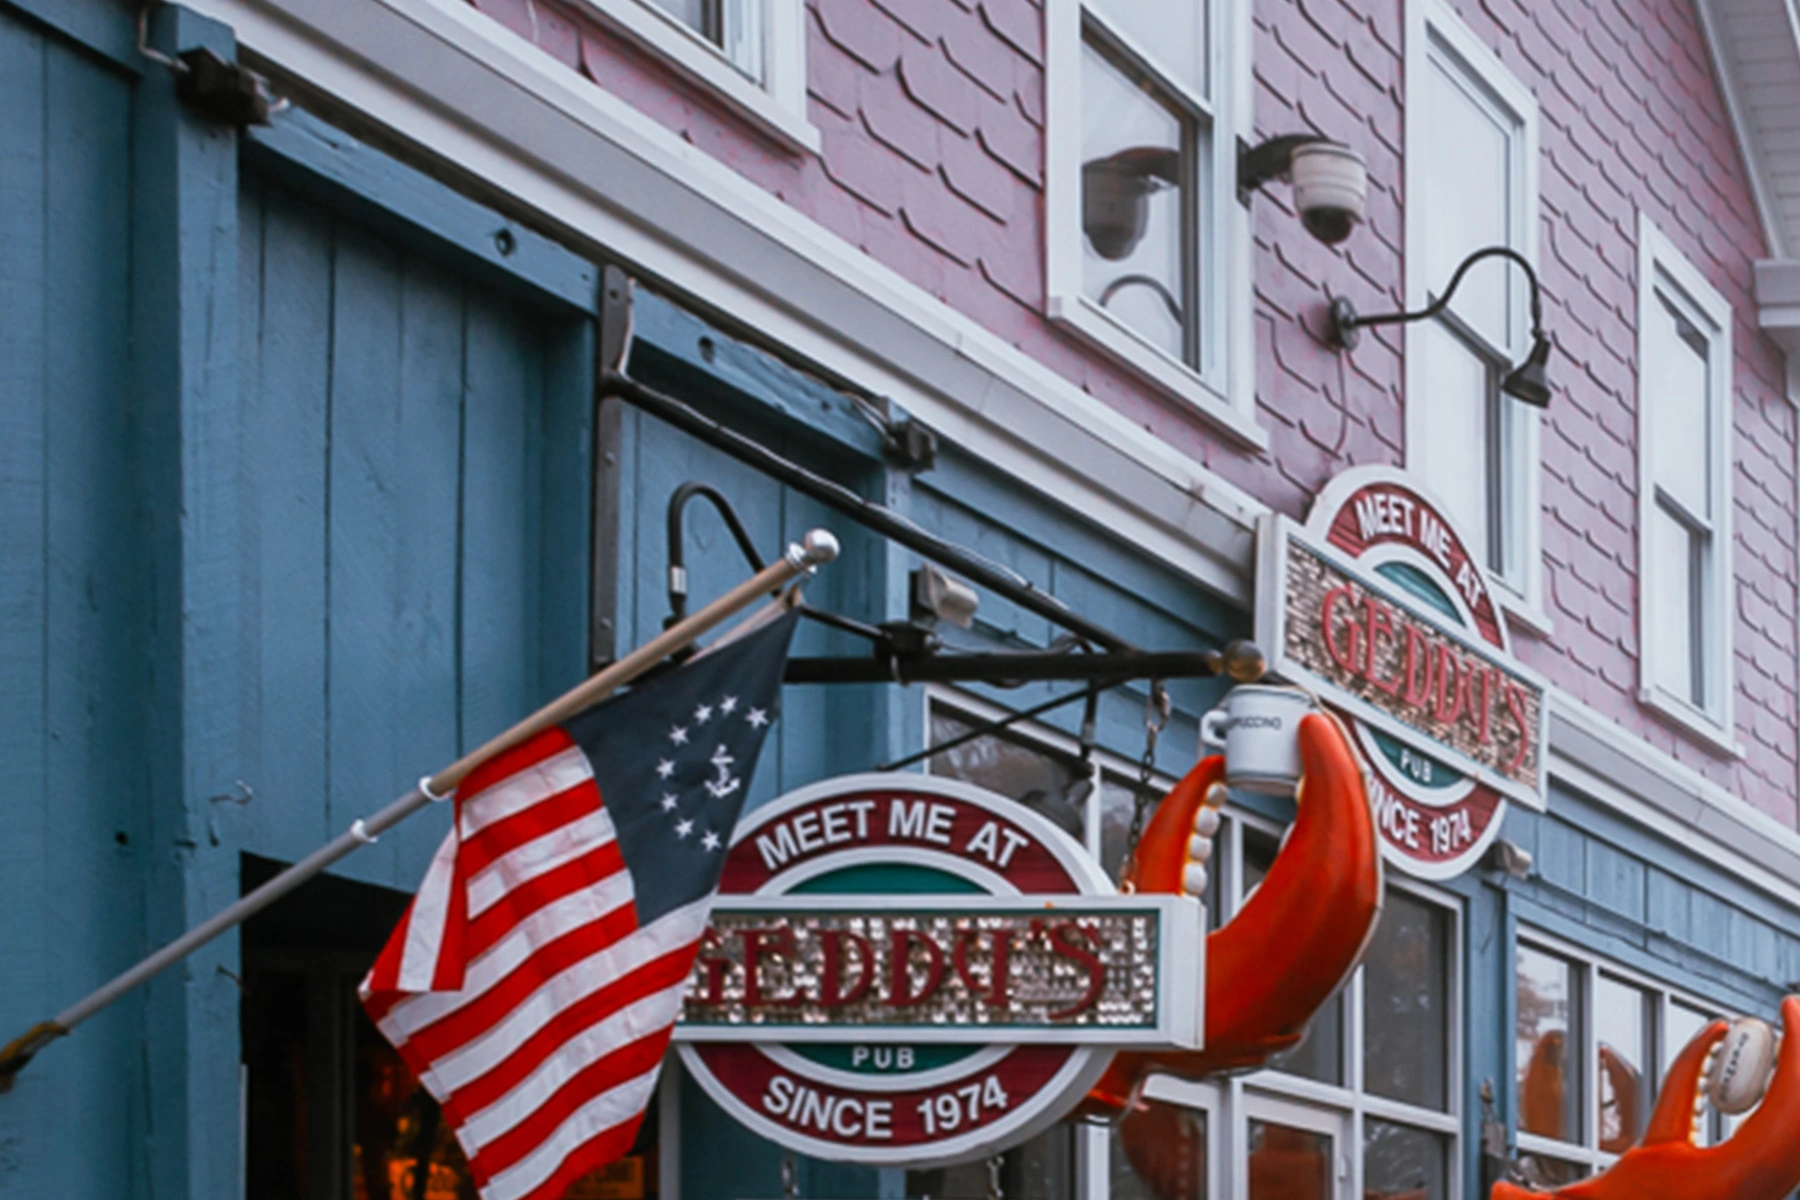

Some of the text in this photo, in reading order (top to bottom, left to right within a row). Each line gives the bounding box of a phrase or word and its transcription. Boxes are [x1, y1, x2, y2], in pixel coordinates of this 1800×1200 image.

[1355, 493, 1487, 606] MEET ME AT
[1401, 748, 1433, 781] PUB
[755, 800, 1028, 871] MEET ME AT
[1429, 807, 1472, 855] 1974
[851, 1046, 916, 1069] PUB
[762, 1075, 1009, 1139] SINCE 1974
